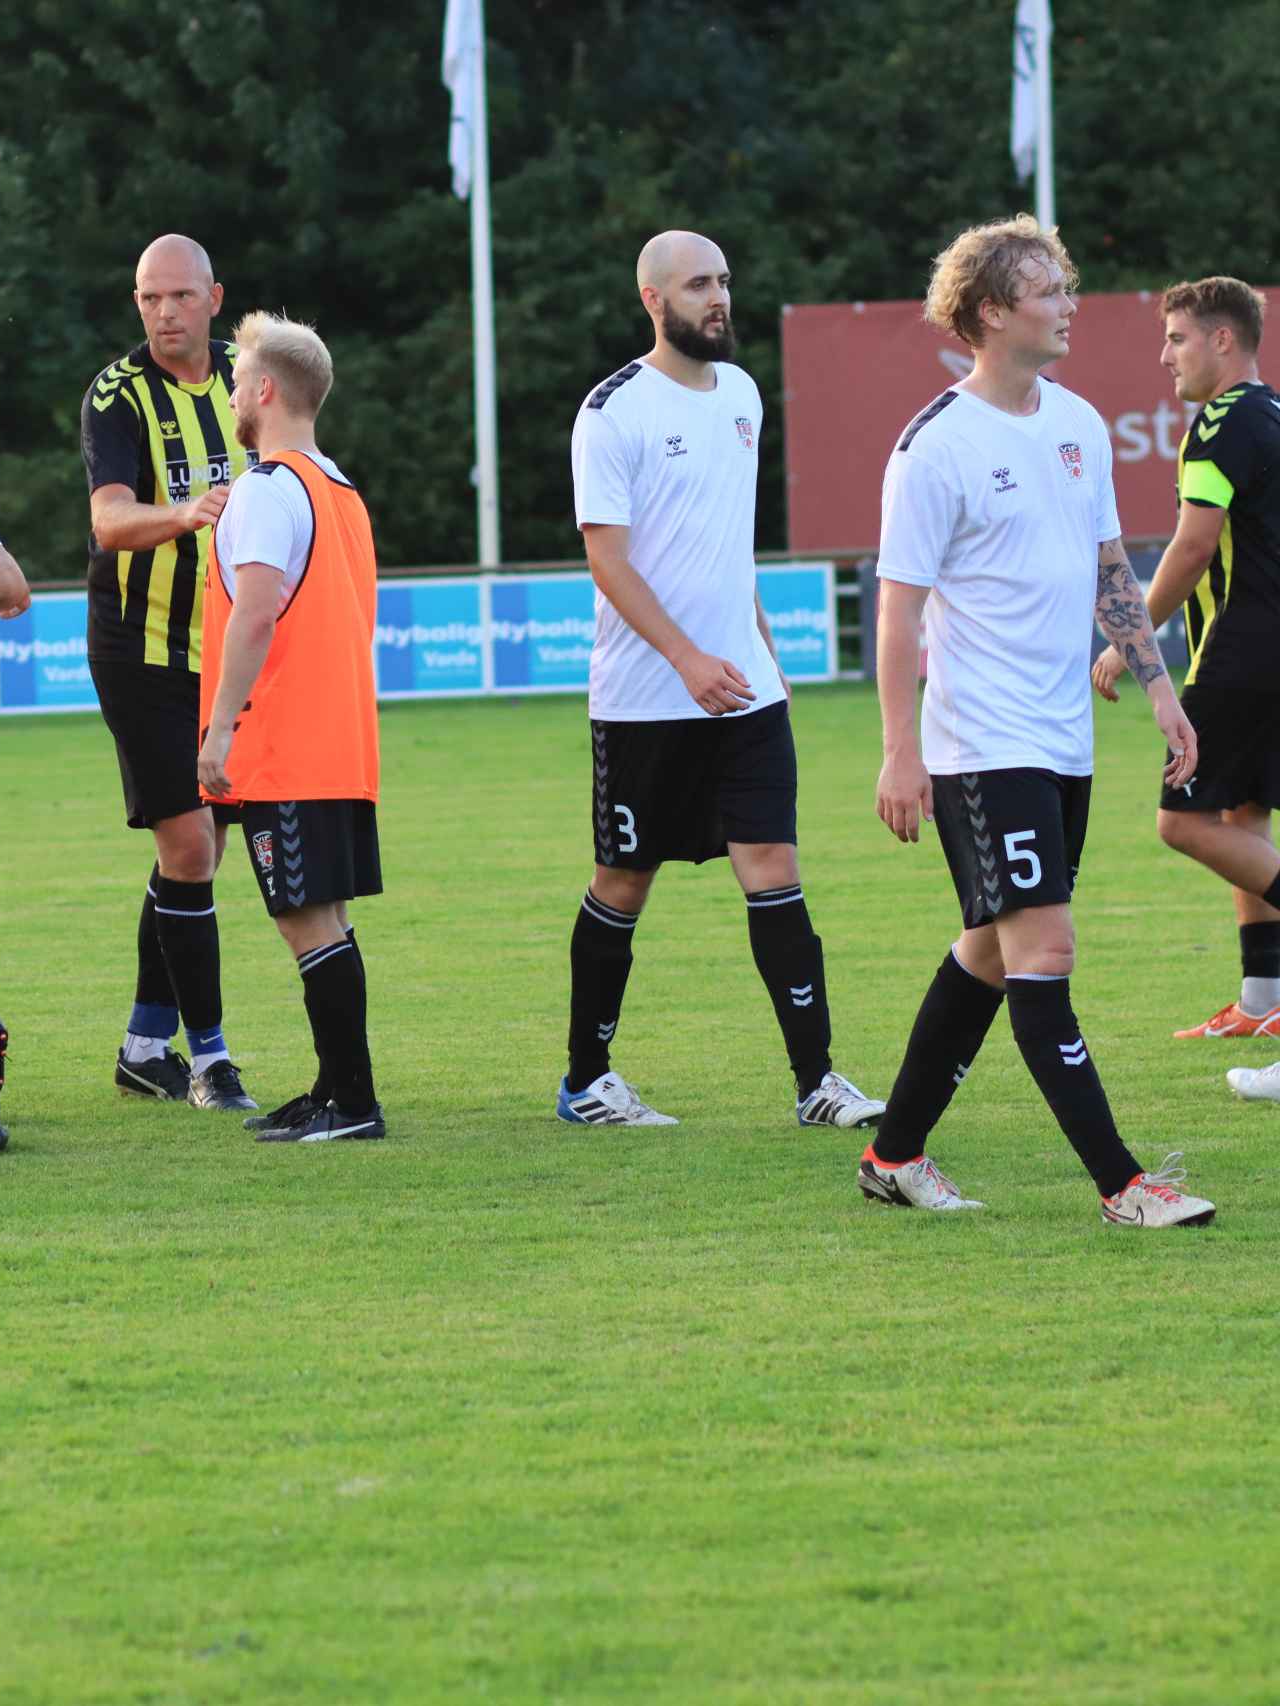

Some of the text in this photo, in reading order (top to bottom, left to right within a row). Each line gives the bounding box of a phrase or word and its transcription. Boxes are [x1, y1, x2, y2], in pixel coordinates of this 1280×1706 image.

[423, 648, 478, 668] Varde
[613, 803, 638, 853] 3
[1003, 829, 1042, 889] 5
